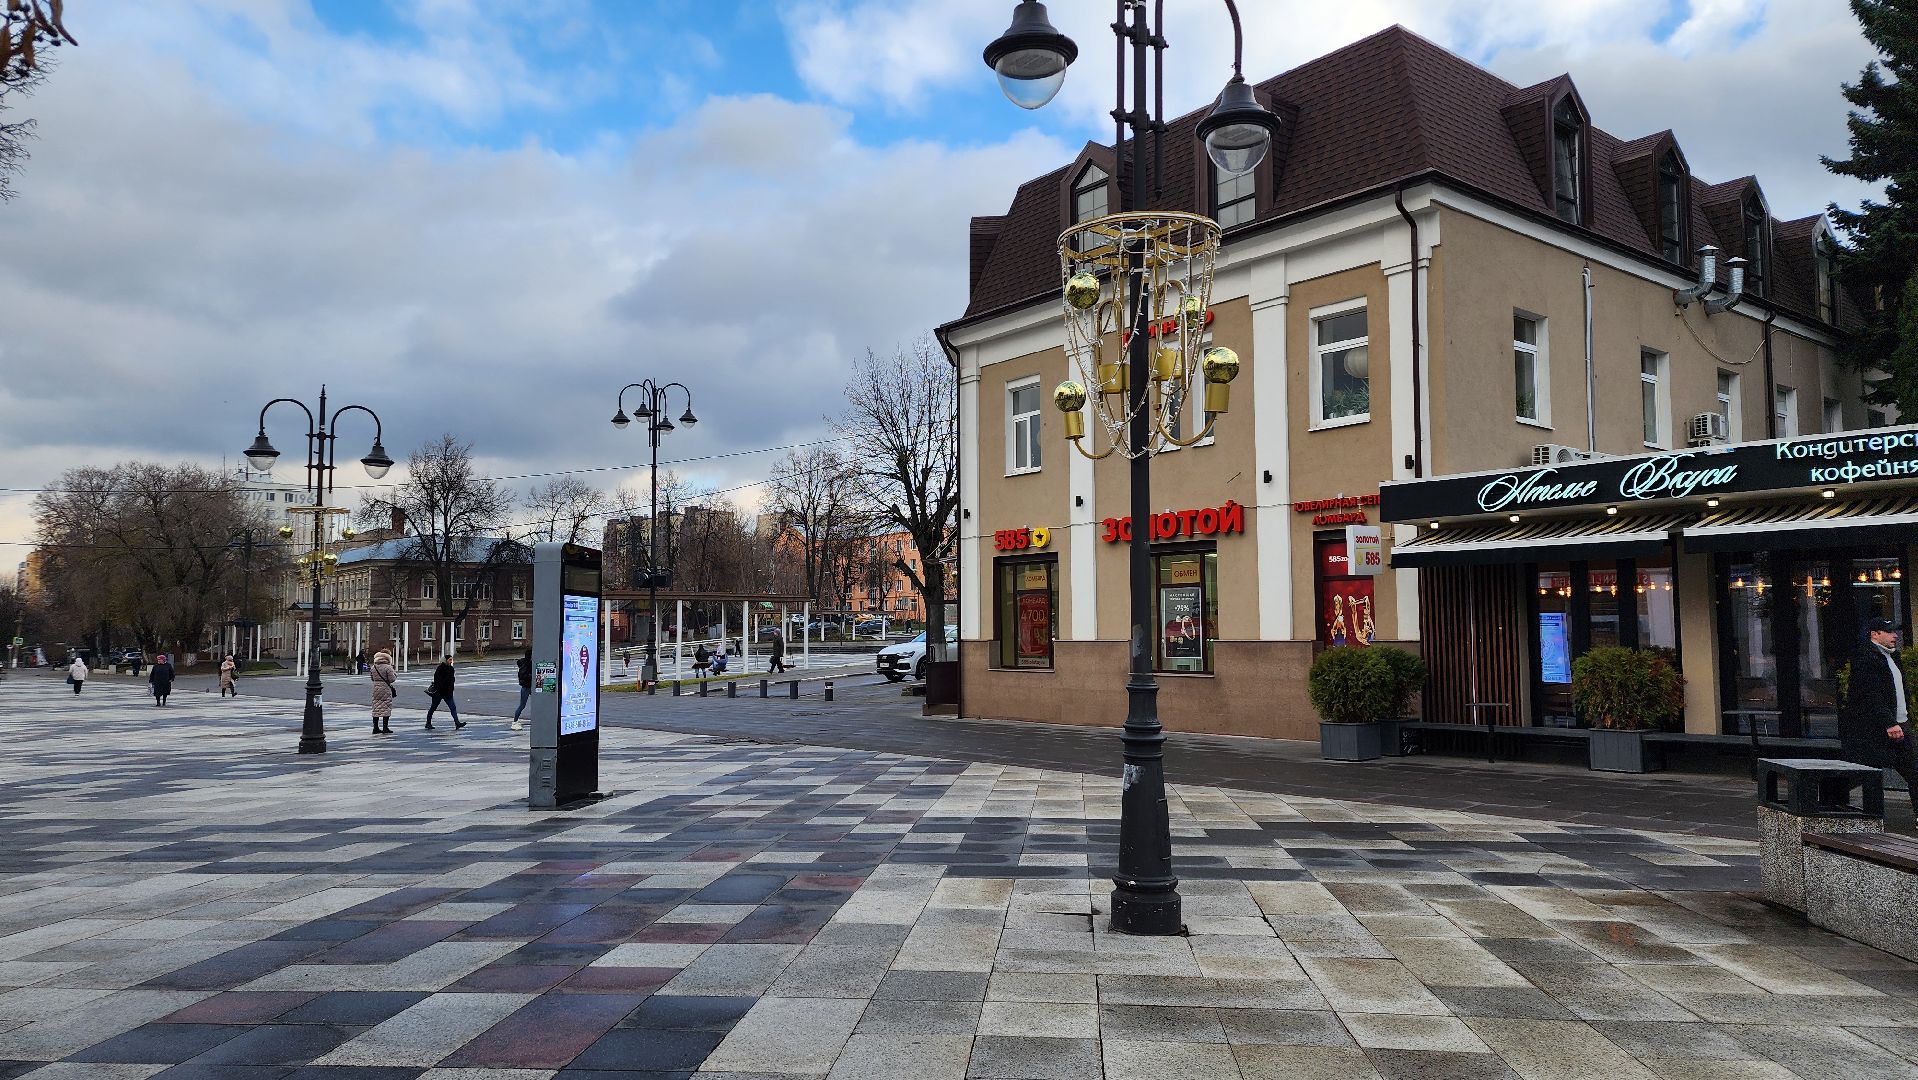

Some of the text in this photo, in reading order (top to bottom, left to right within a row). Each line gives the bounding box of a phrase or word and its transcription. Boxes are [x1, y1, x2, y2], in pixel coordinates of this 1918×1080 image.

[1478, 453, 1738, 511] Ателье Вкуса
[1294, 497, 1357, 512] ЮВЕЛИРНАЯ
[1312, 511, 1367, 526] ЛОМБАРД
[994, 528, 1030, 551] 585
[1365, 551, 1381, 566] 585
[1173, 569, 1198, 578] ОБМЕН
